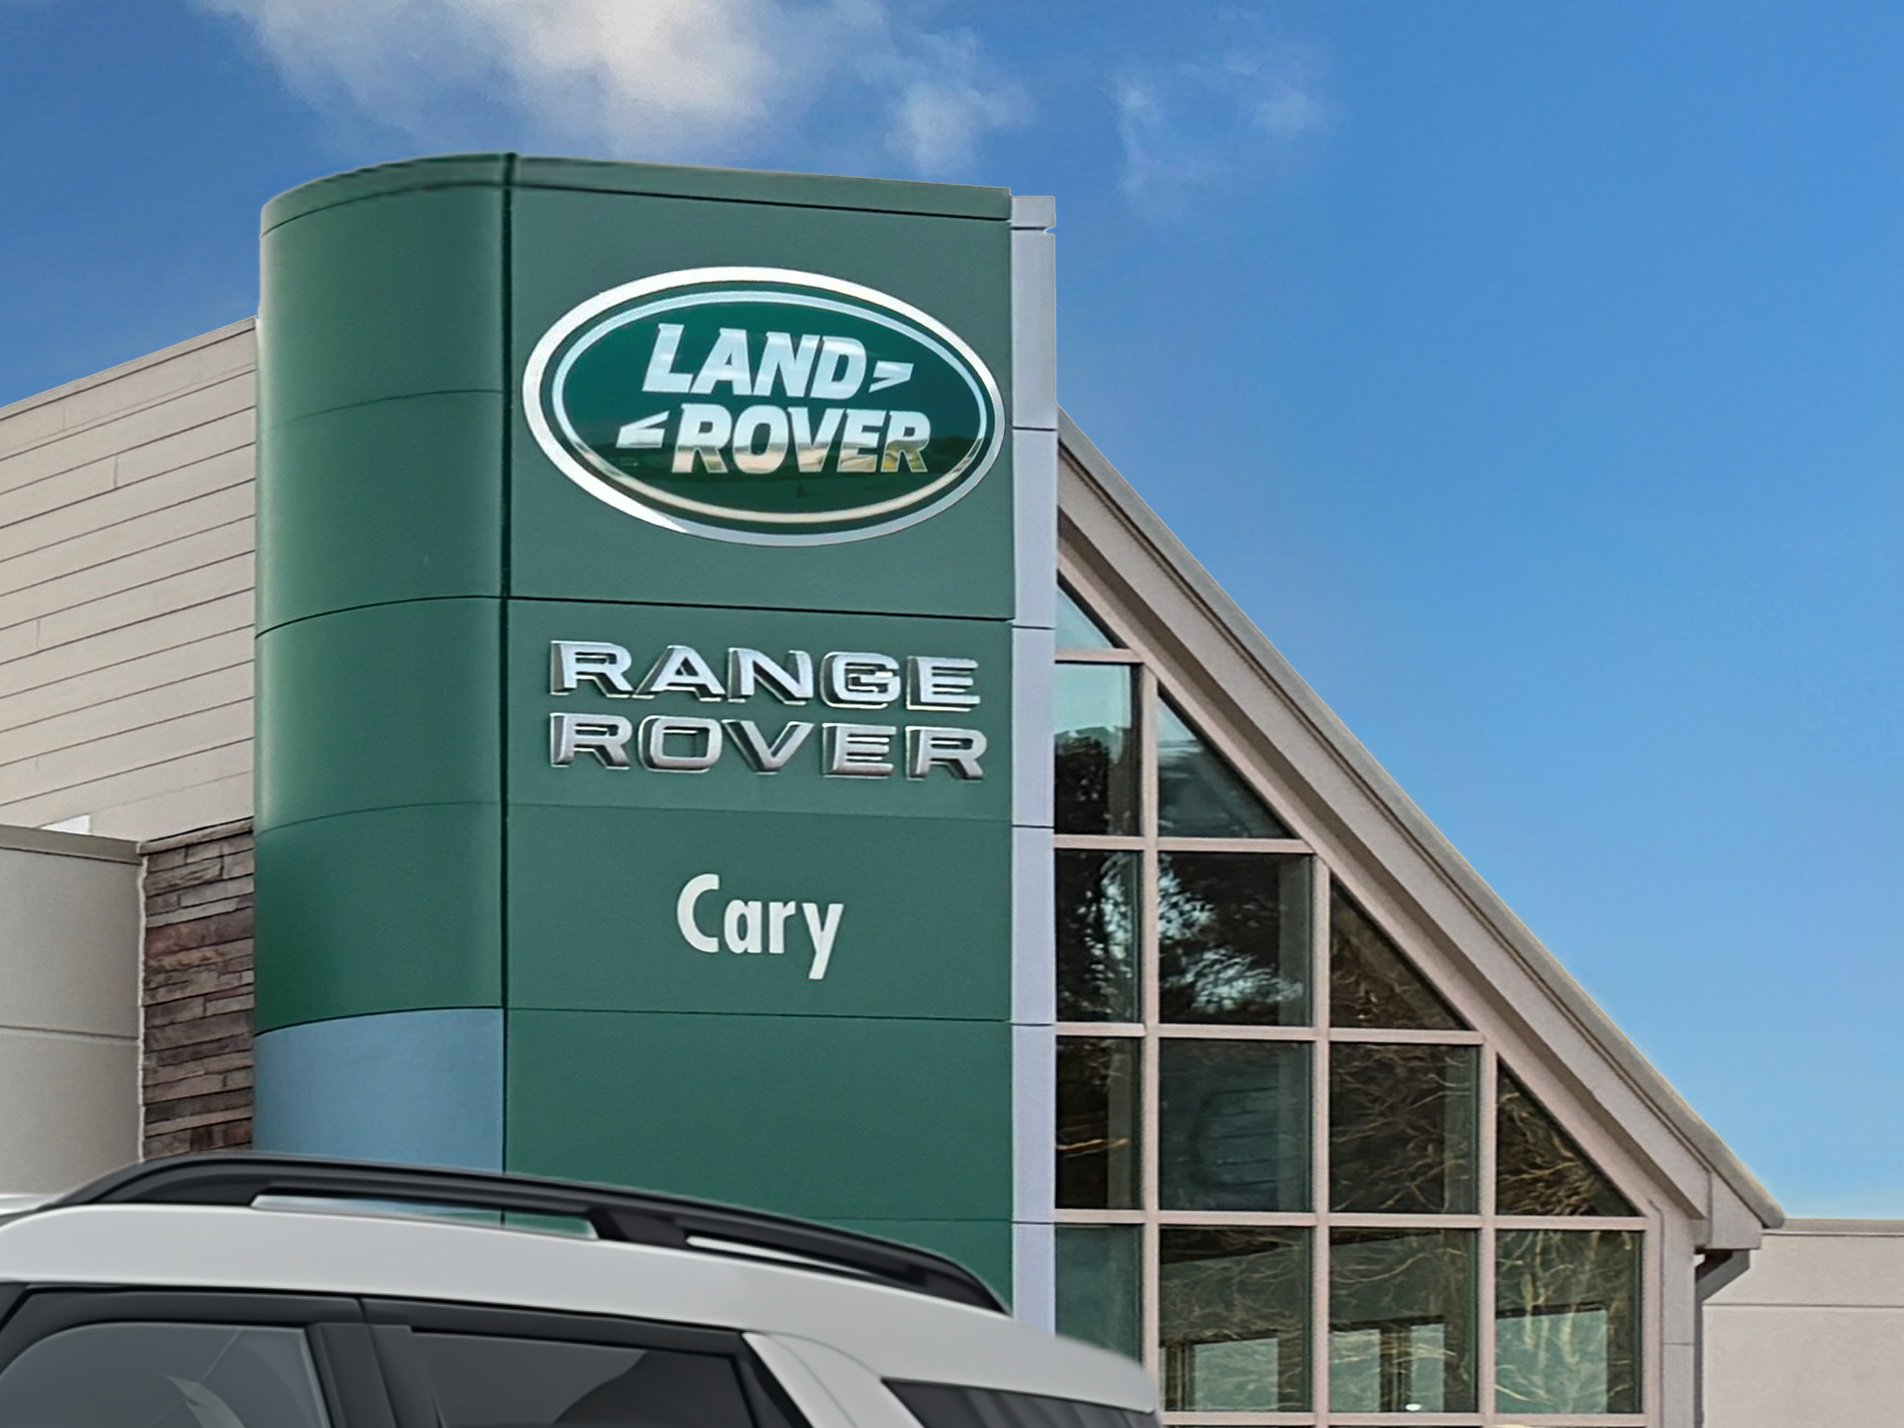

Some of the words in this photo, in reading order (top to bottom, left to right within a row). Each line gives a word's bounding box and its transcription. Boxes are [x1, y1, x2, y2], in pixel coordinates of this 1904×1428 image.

[642, 323, 870, 401] LAND
[671, 404, 930, 474] ROVER
[549, 640, 981, 711] RANGE
[549, 712, 988, 781] ROVER
[676, 873, 844, 981] Cary
